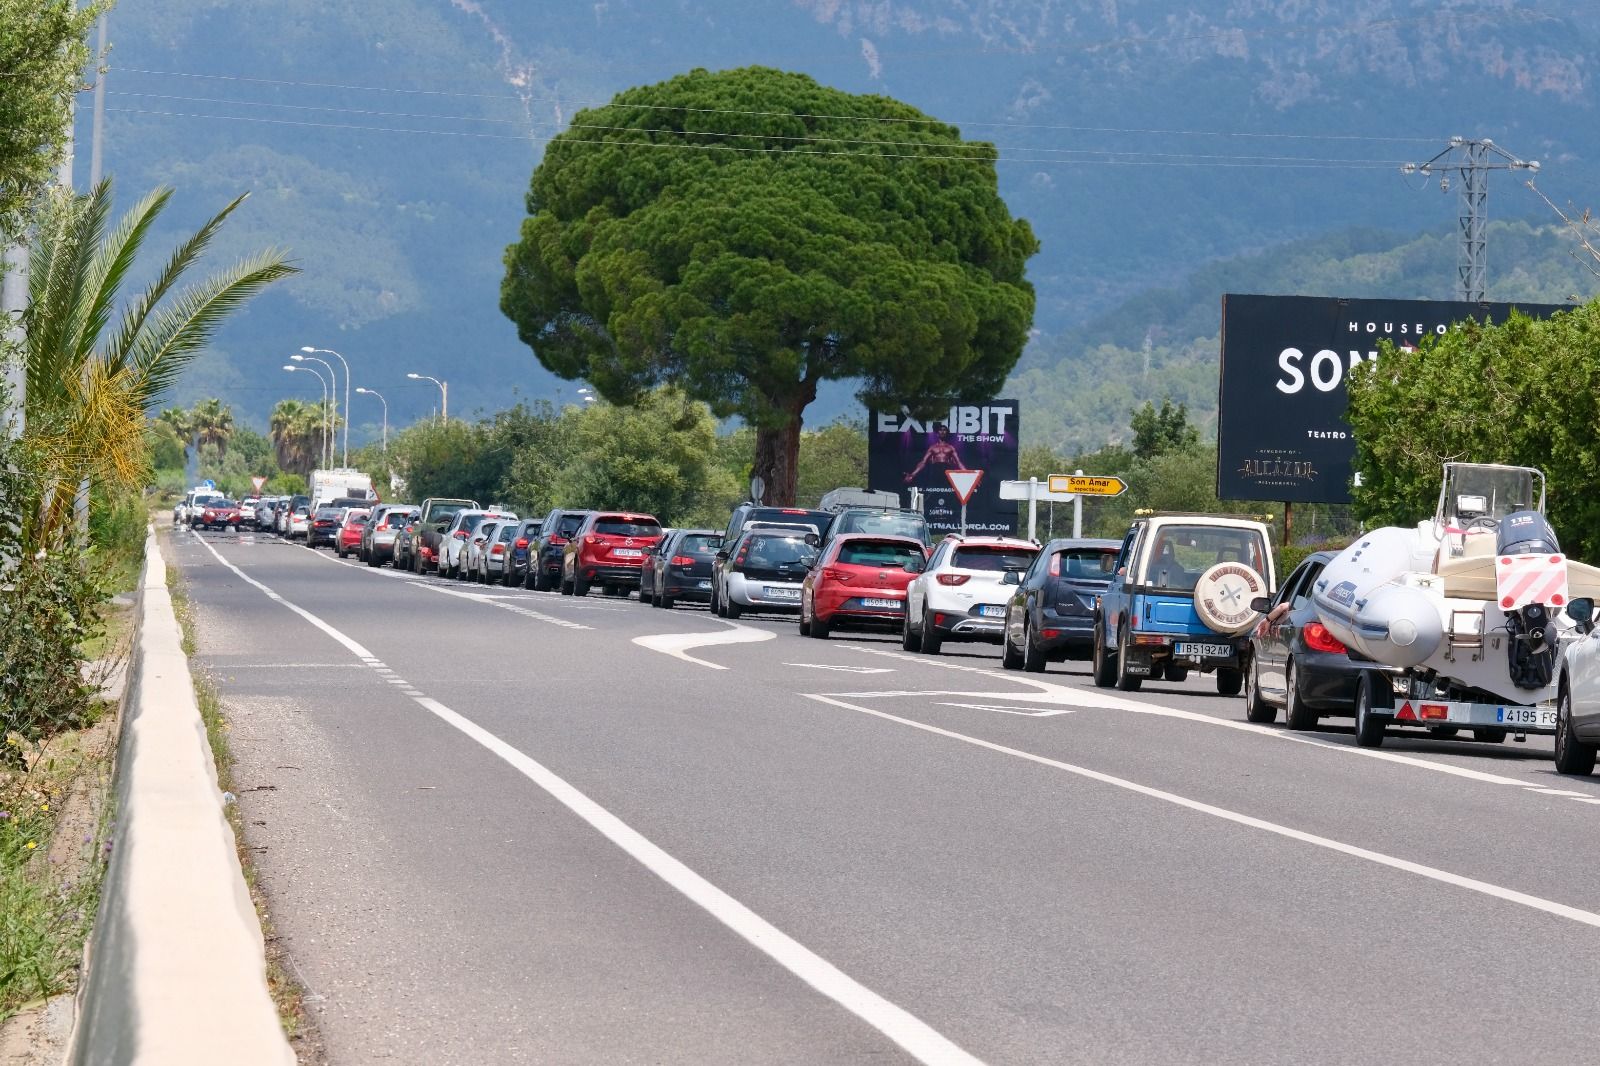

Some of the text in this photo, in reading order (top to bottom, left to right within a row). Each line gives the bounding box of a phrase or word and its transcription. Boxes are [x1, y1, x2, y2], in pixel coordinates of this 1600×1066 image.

[1349, 322, 1423, 334] HOUSE
[957, 434, 1005, 443] THE SHOW
[1307, 430, 1346, 439] TEATRO
[1089, 478, 1110, 486] Amar
[1506, 709, 1537, 723] 4195
